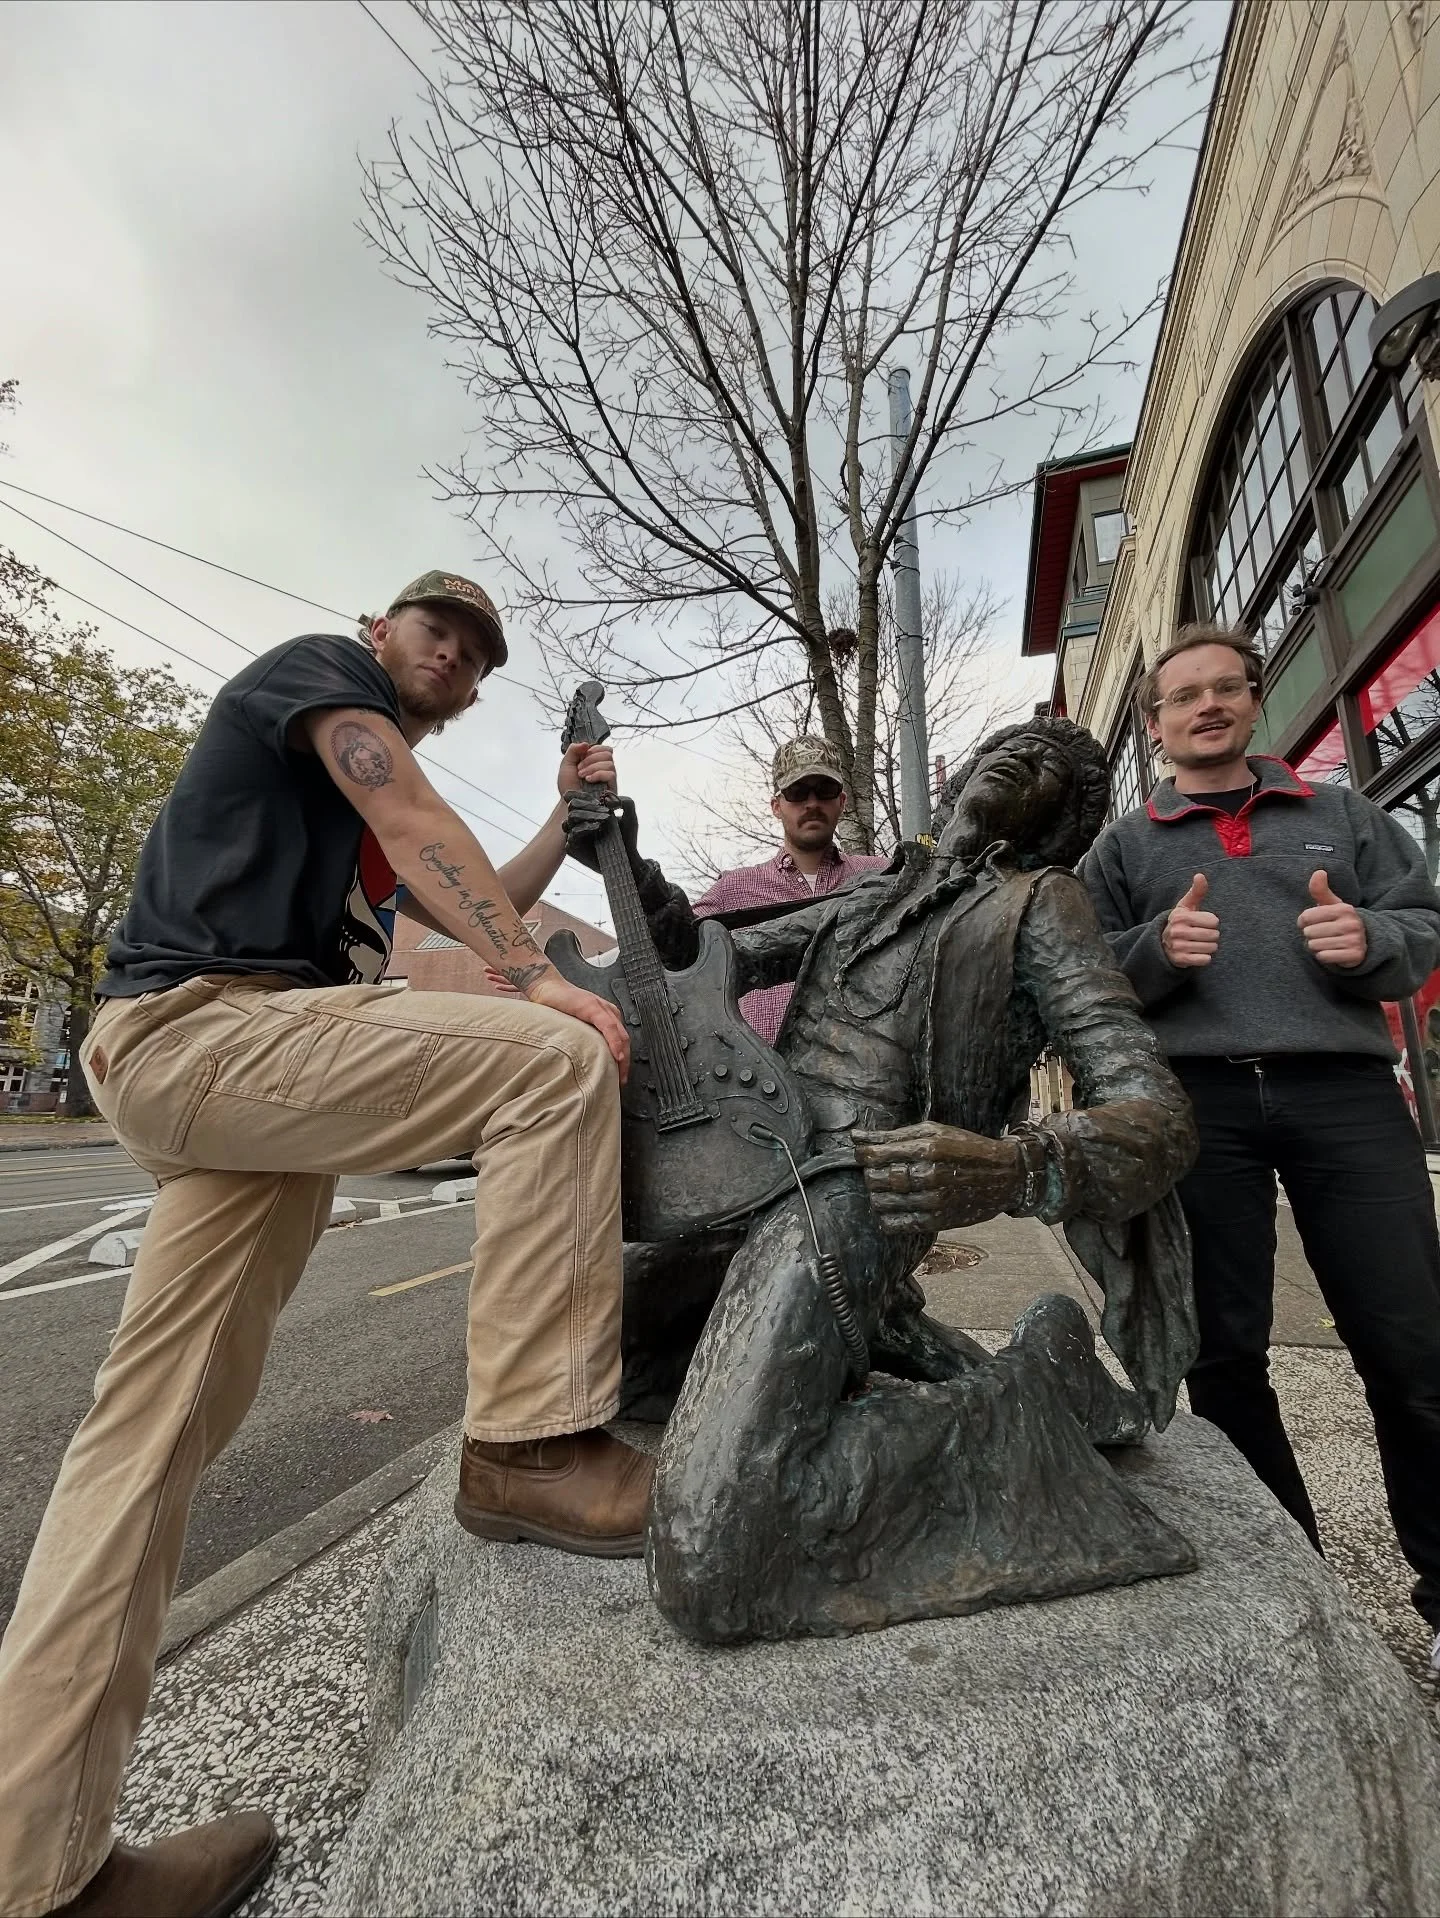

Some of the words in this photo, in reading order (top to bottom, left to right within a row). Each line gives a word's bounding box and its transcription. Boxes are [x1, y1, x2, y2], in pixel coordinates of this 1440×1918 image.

[419, 842, 466, 889] Everything
[458, 888, 472, 900] in
[459, 899, 509, 960] Moderation
